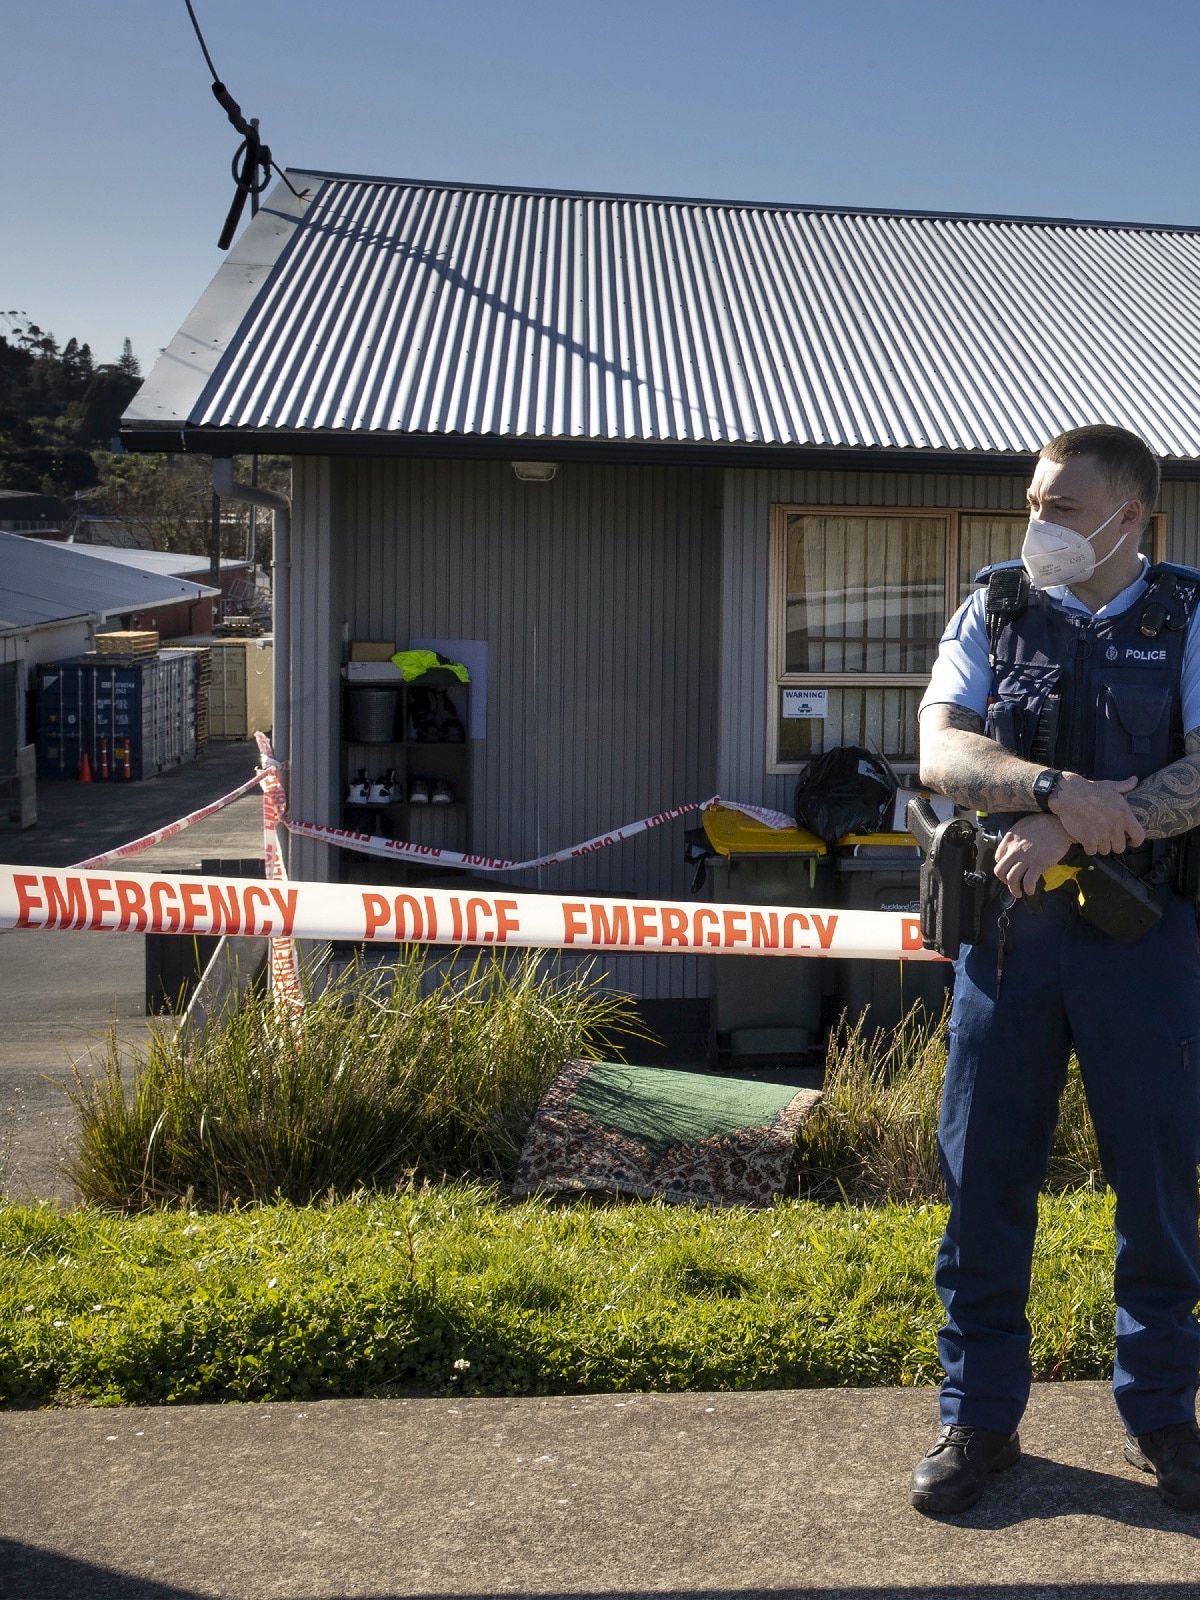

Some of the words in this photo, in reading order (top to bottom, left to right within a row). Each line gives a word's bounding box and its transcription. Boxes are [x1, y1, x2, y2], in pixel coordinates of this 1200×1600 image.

[1125, 648, 1167, 660] POLICE
[13, 874, 298, 936] EMERGENCY
[362, 893, 520, 942] POLICE
[562, 902, 839, 950] EMERGENCY
[880, 903, 910, 911] Auckland
